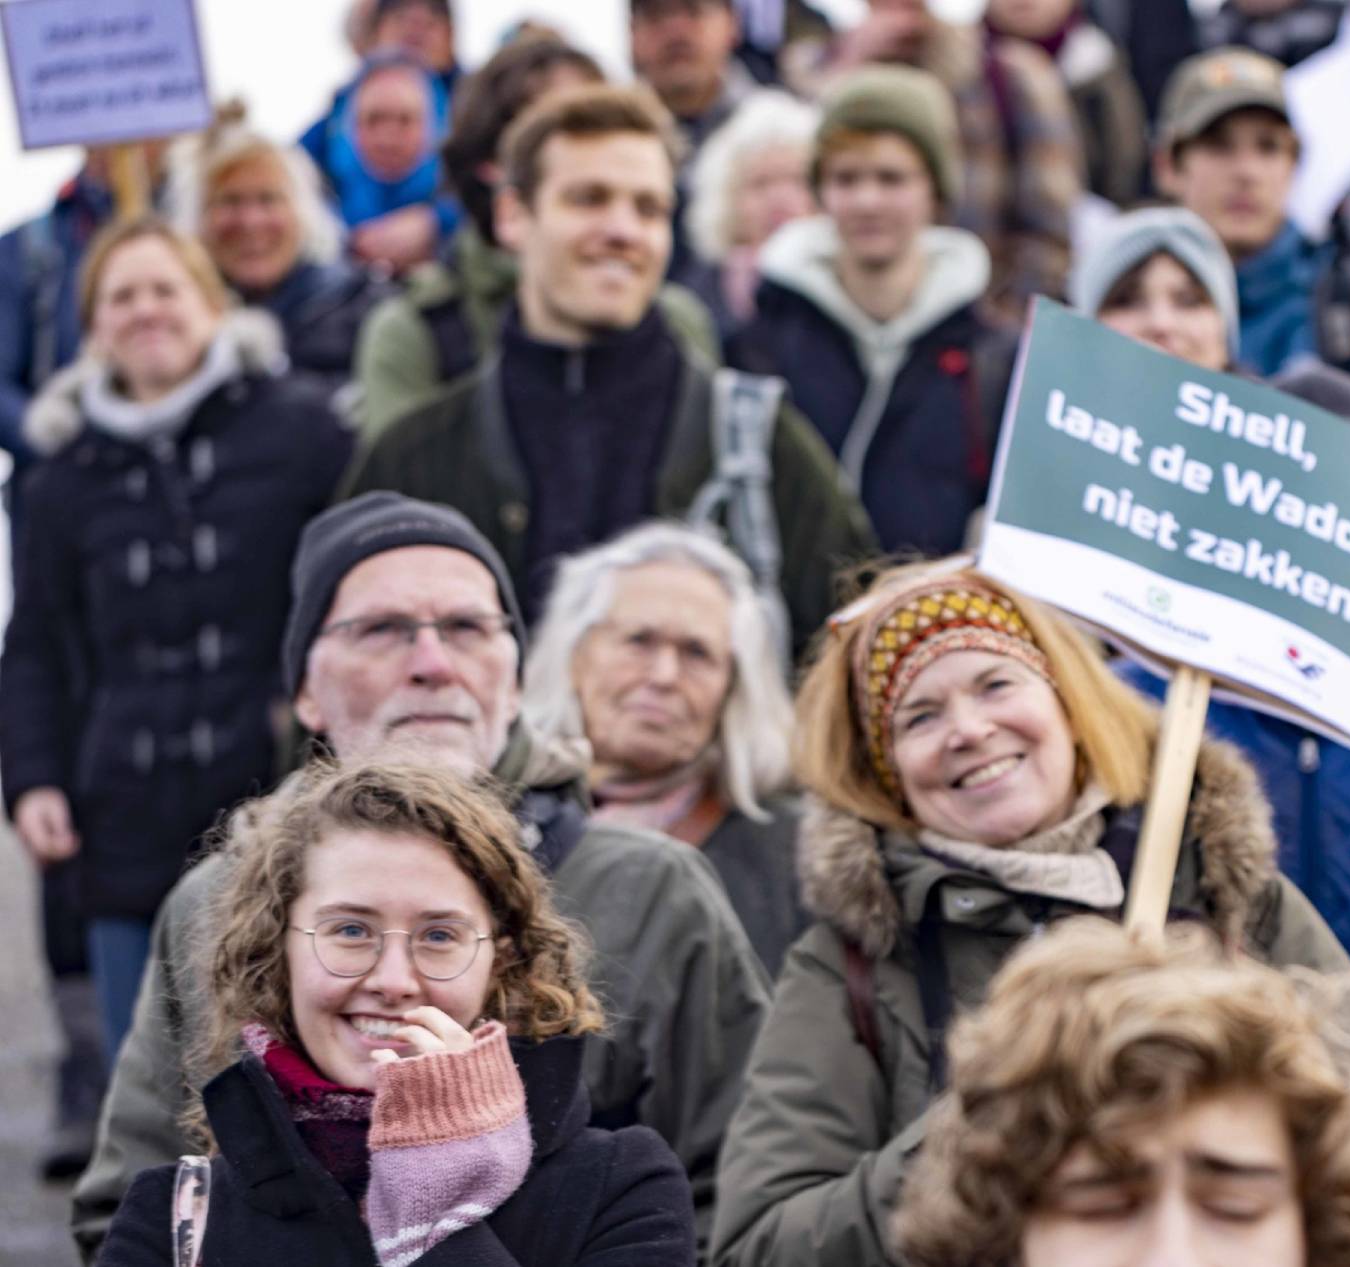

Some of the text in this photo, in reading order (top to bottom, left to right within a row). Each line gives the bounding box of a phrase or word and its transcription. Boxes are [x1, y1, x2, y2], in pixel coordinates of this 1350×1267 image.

[1045, 389, 1142, 466] laat
[1149, 443, 1213, 495] de
[1175, 381, 1317, 472] Shell,
[1082, 483, 1178, 551] niet
